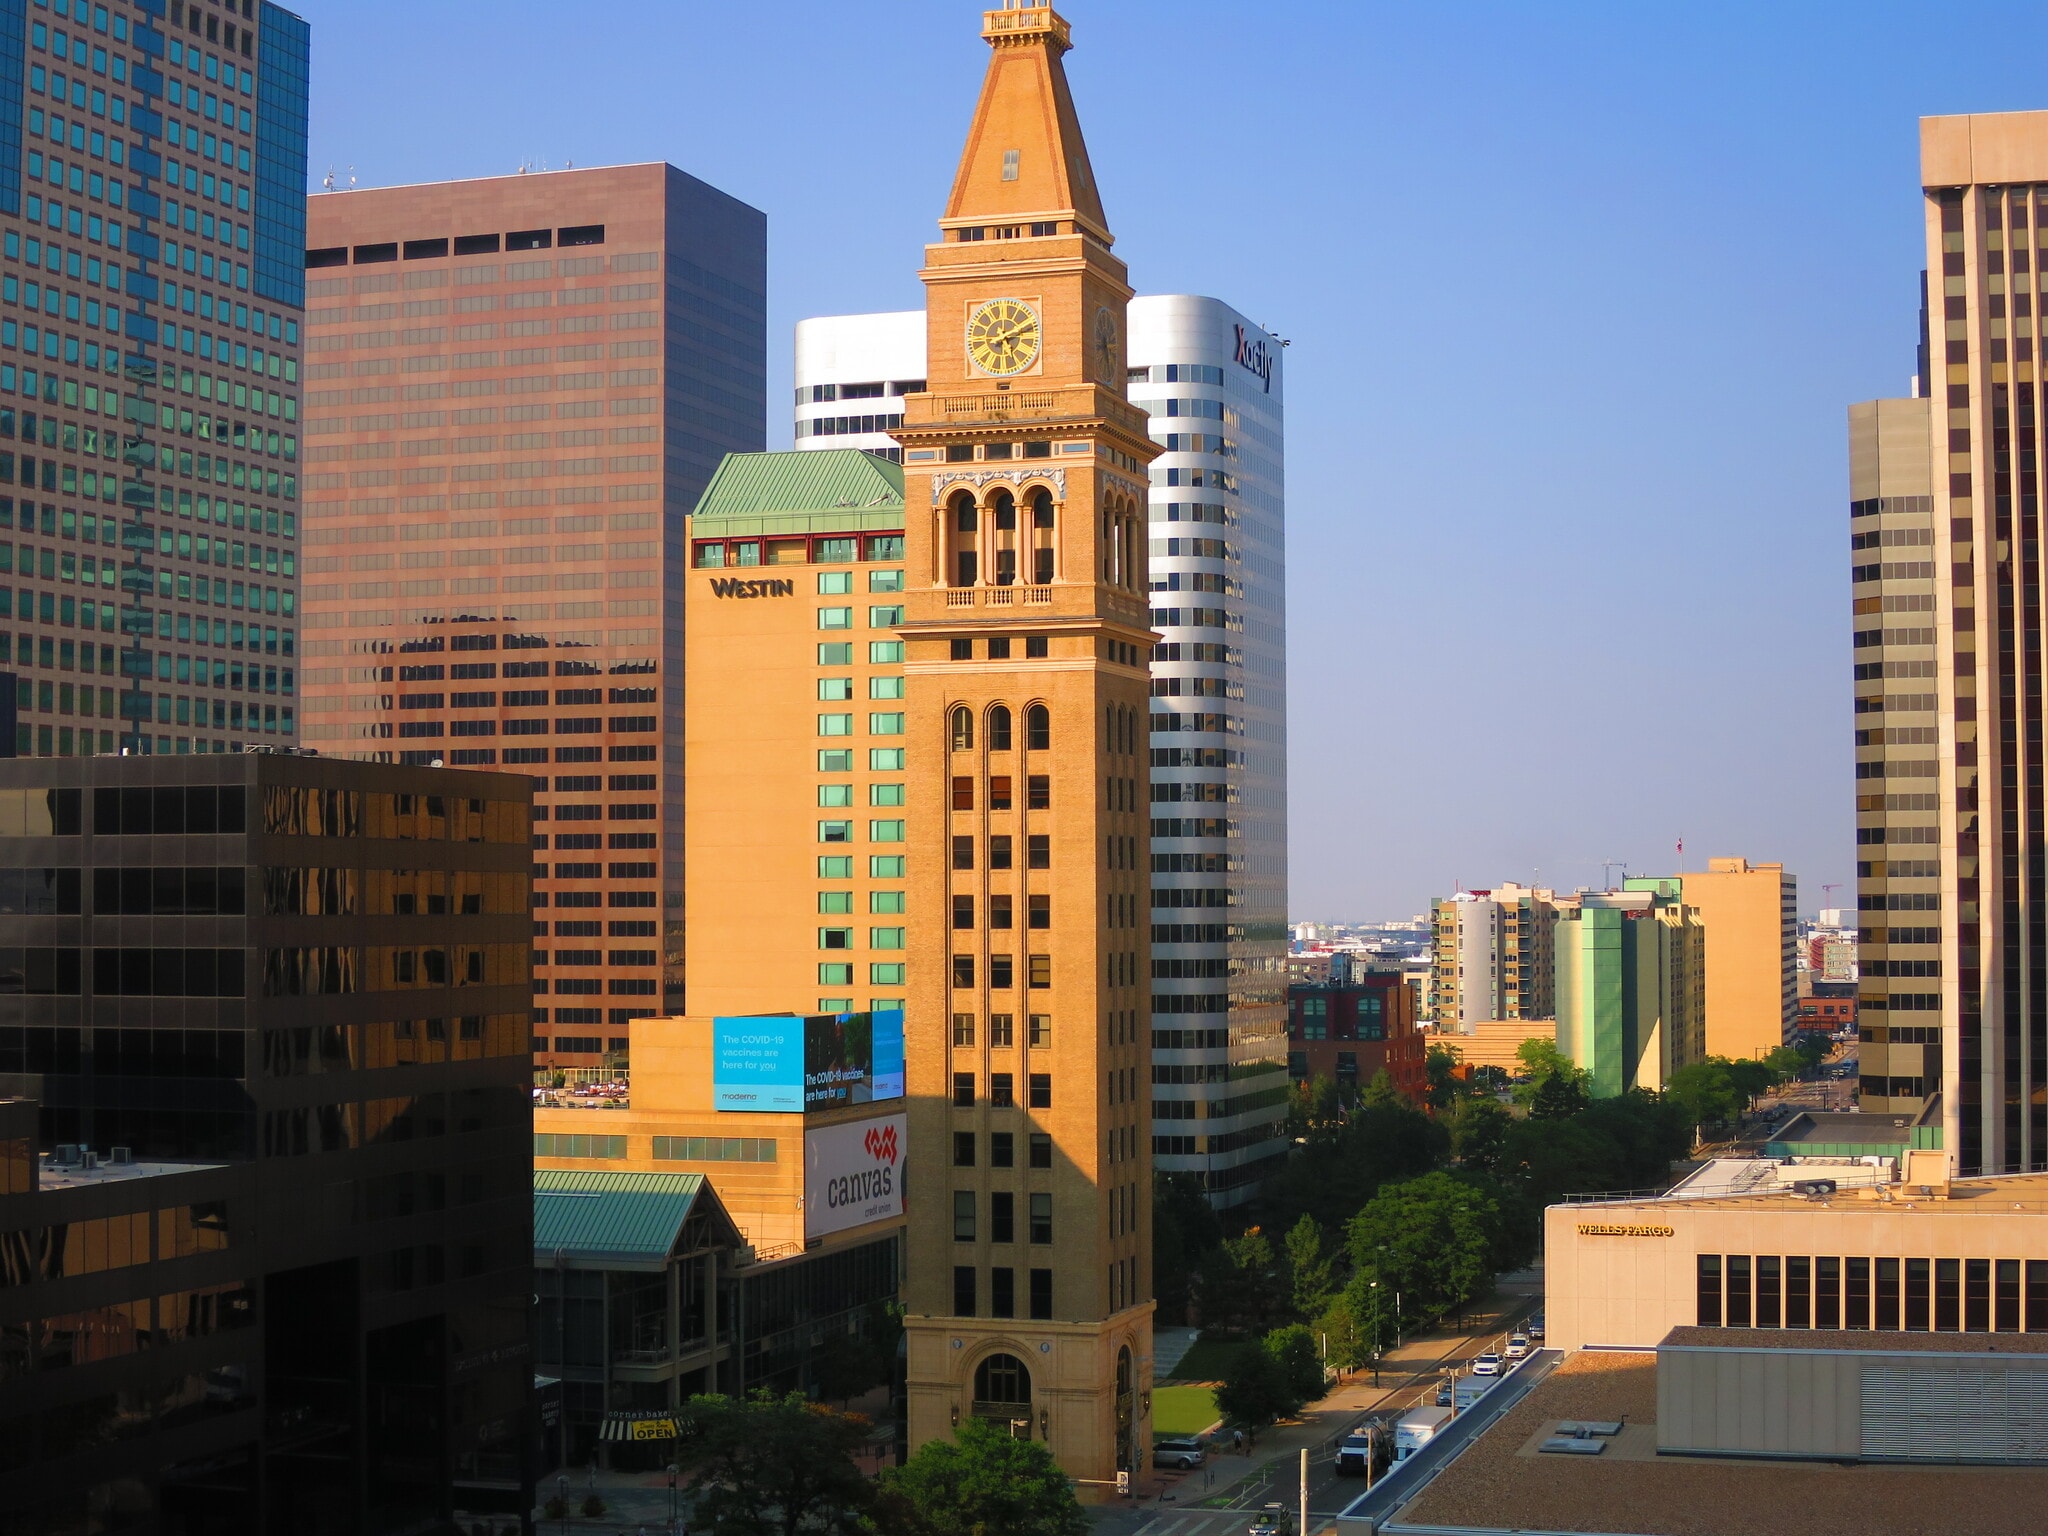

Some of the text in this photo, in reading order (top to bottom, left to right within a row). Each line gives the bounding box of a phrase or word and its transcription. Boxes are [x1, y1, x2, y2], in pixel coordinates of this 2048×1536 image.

[1233, 323, 1273, 394] Xactly
[709, 577, 794, 599] WESTIN
[722, 1035, 784, 1045] The COVID-19
[722, 1048, 779, 1058] vaccines are
[722, 1060, 776, 1072] here for you
[805, 1068, 864, 1085] The COVID-19 vaccines
[721, 1093, 758, 1101] moderna
[805, 1091, 815, 1102] are
[816, 1089, 828, 1099] here
[828, 1087, 836, 1098] for
[828, 1167, 892, 1208] canvas
[864, 1203, 891, 1218] credit union
[1576, 1224, 1675, 1237] WELLS FARGO
[608, 1410, 644, 1419] corner
[636, 1428, 673, 1439] OPEN
